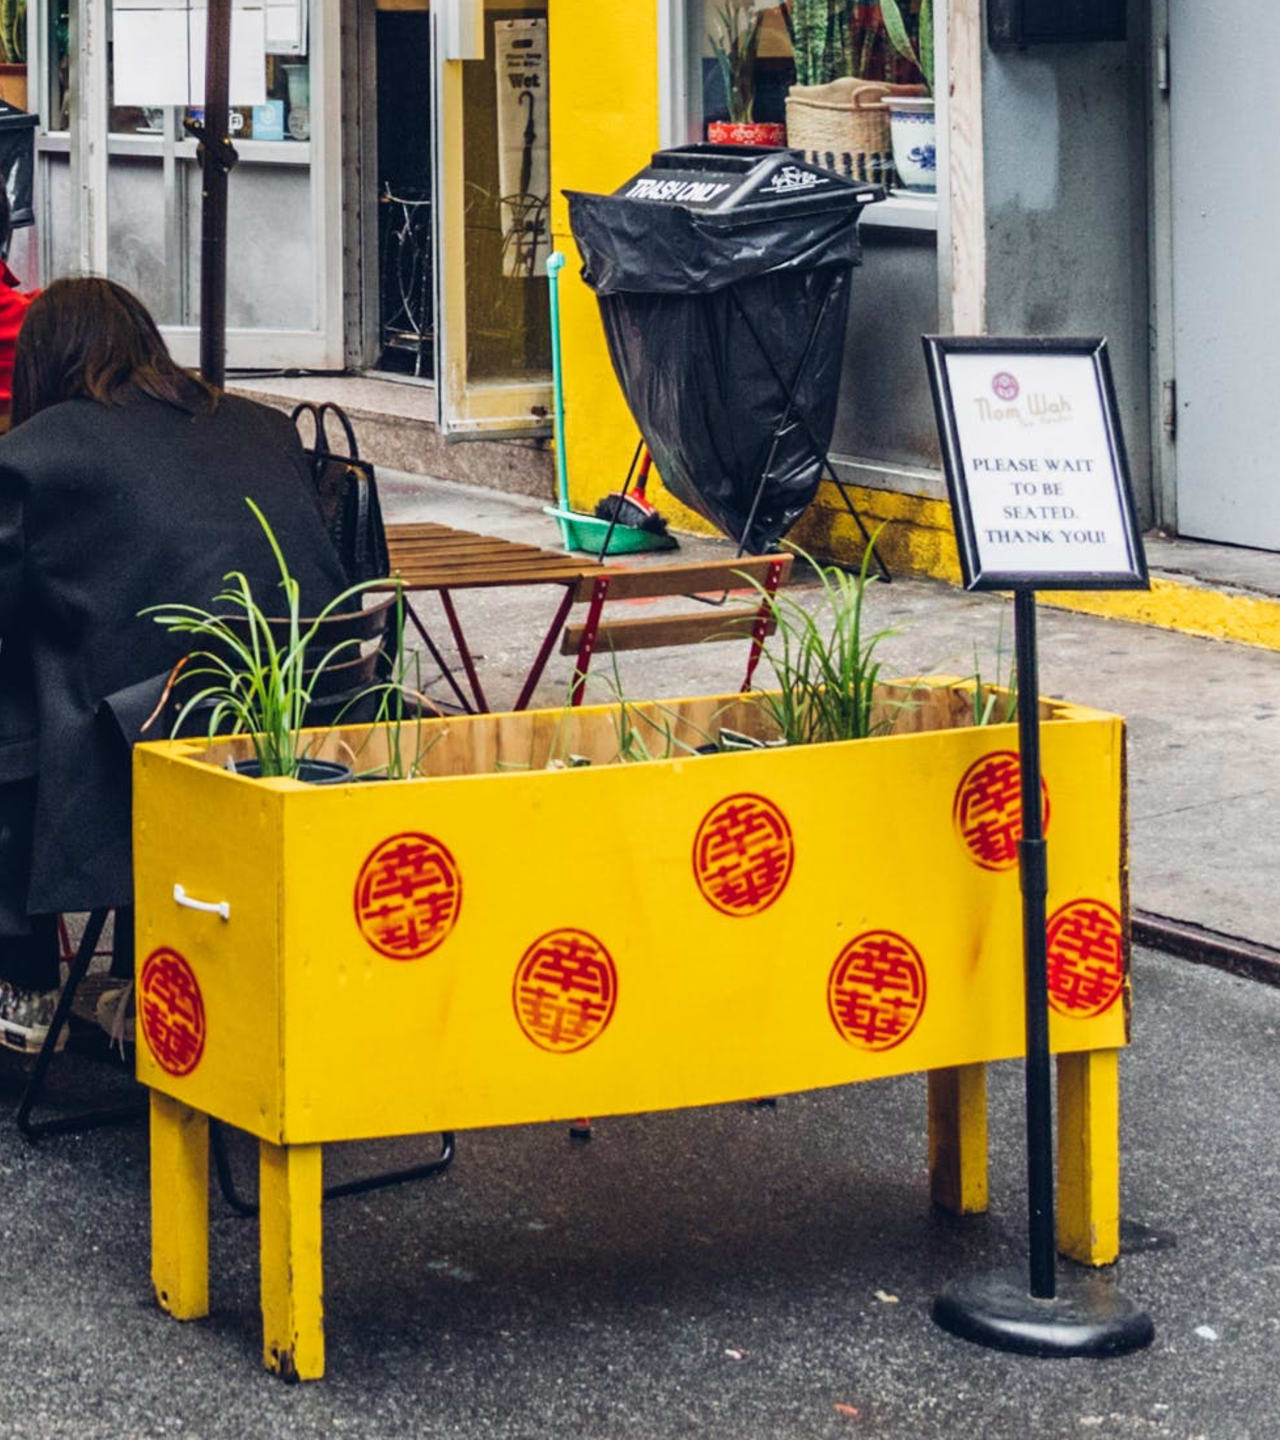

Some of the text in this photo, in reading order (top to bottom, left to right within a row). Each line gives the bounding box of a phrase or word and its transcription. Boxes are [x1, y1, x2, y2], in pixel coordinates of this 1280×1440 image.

[625, 179, 731, 202] TRASH ONLY
[974, 392, 1073, 422] Nom Wah
[972, 458, 1094, 472] PLEASE WAIT
[1011, 482, 1063, 496] TO BE
[1003, 507, 1079, 520] SEATED.
[985, 530, 1106, 543] THANK YOU!
